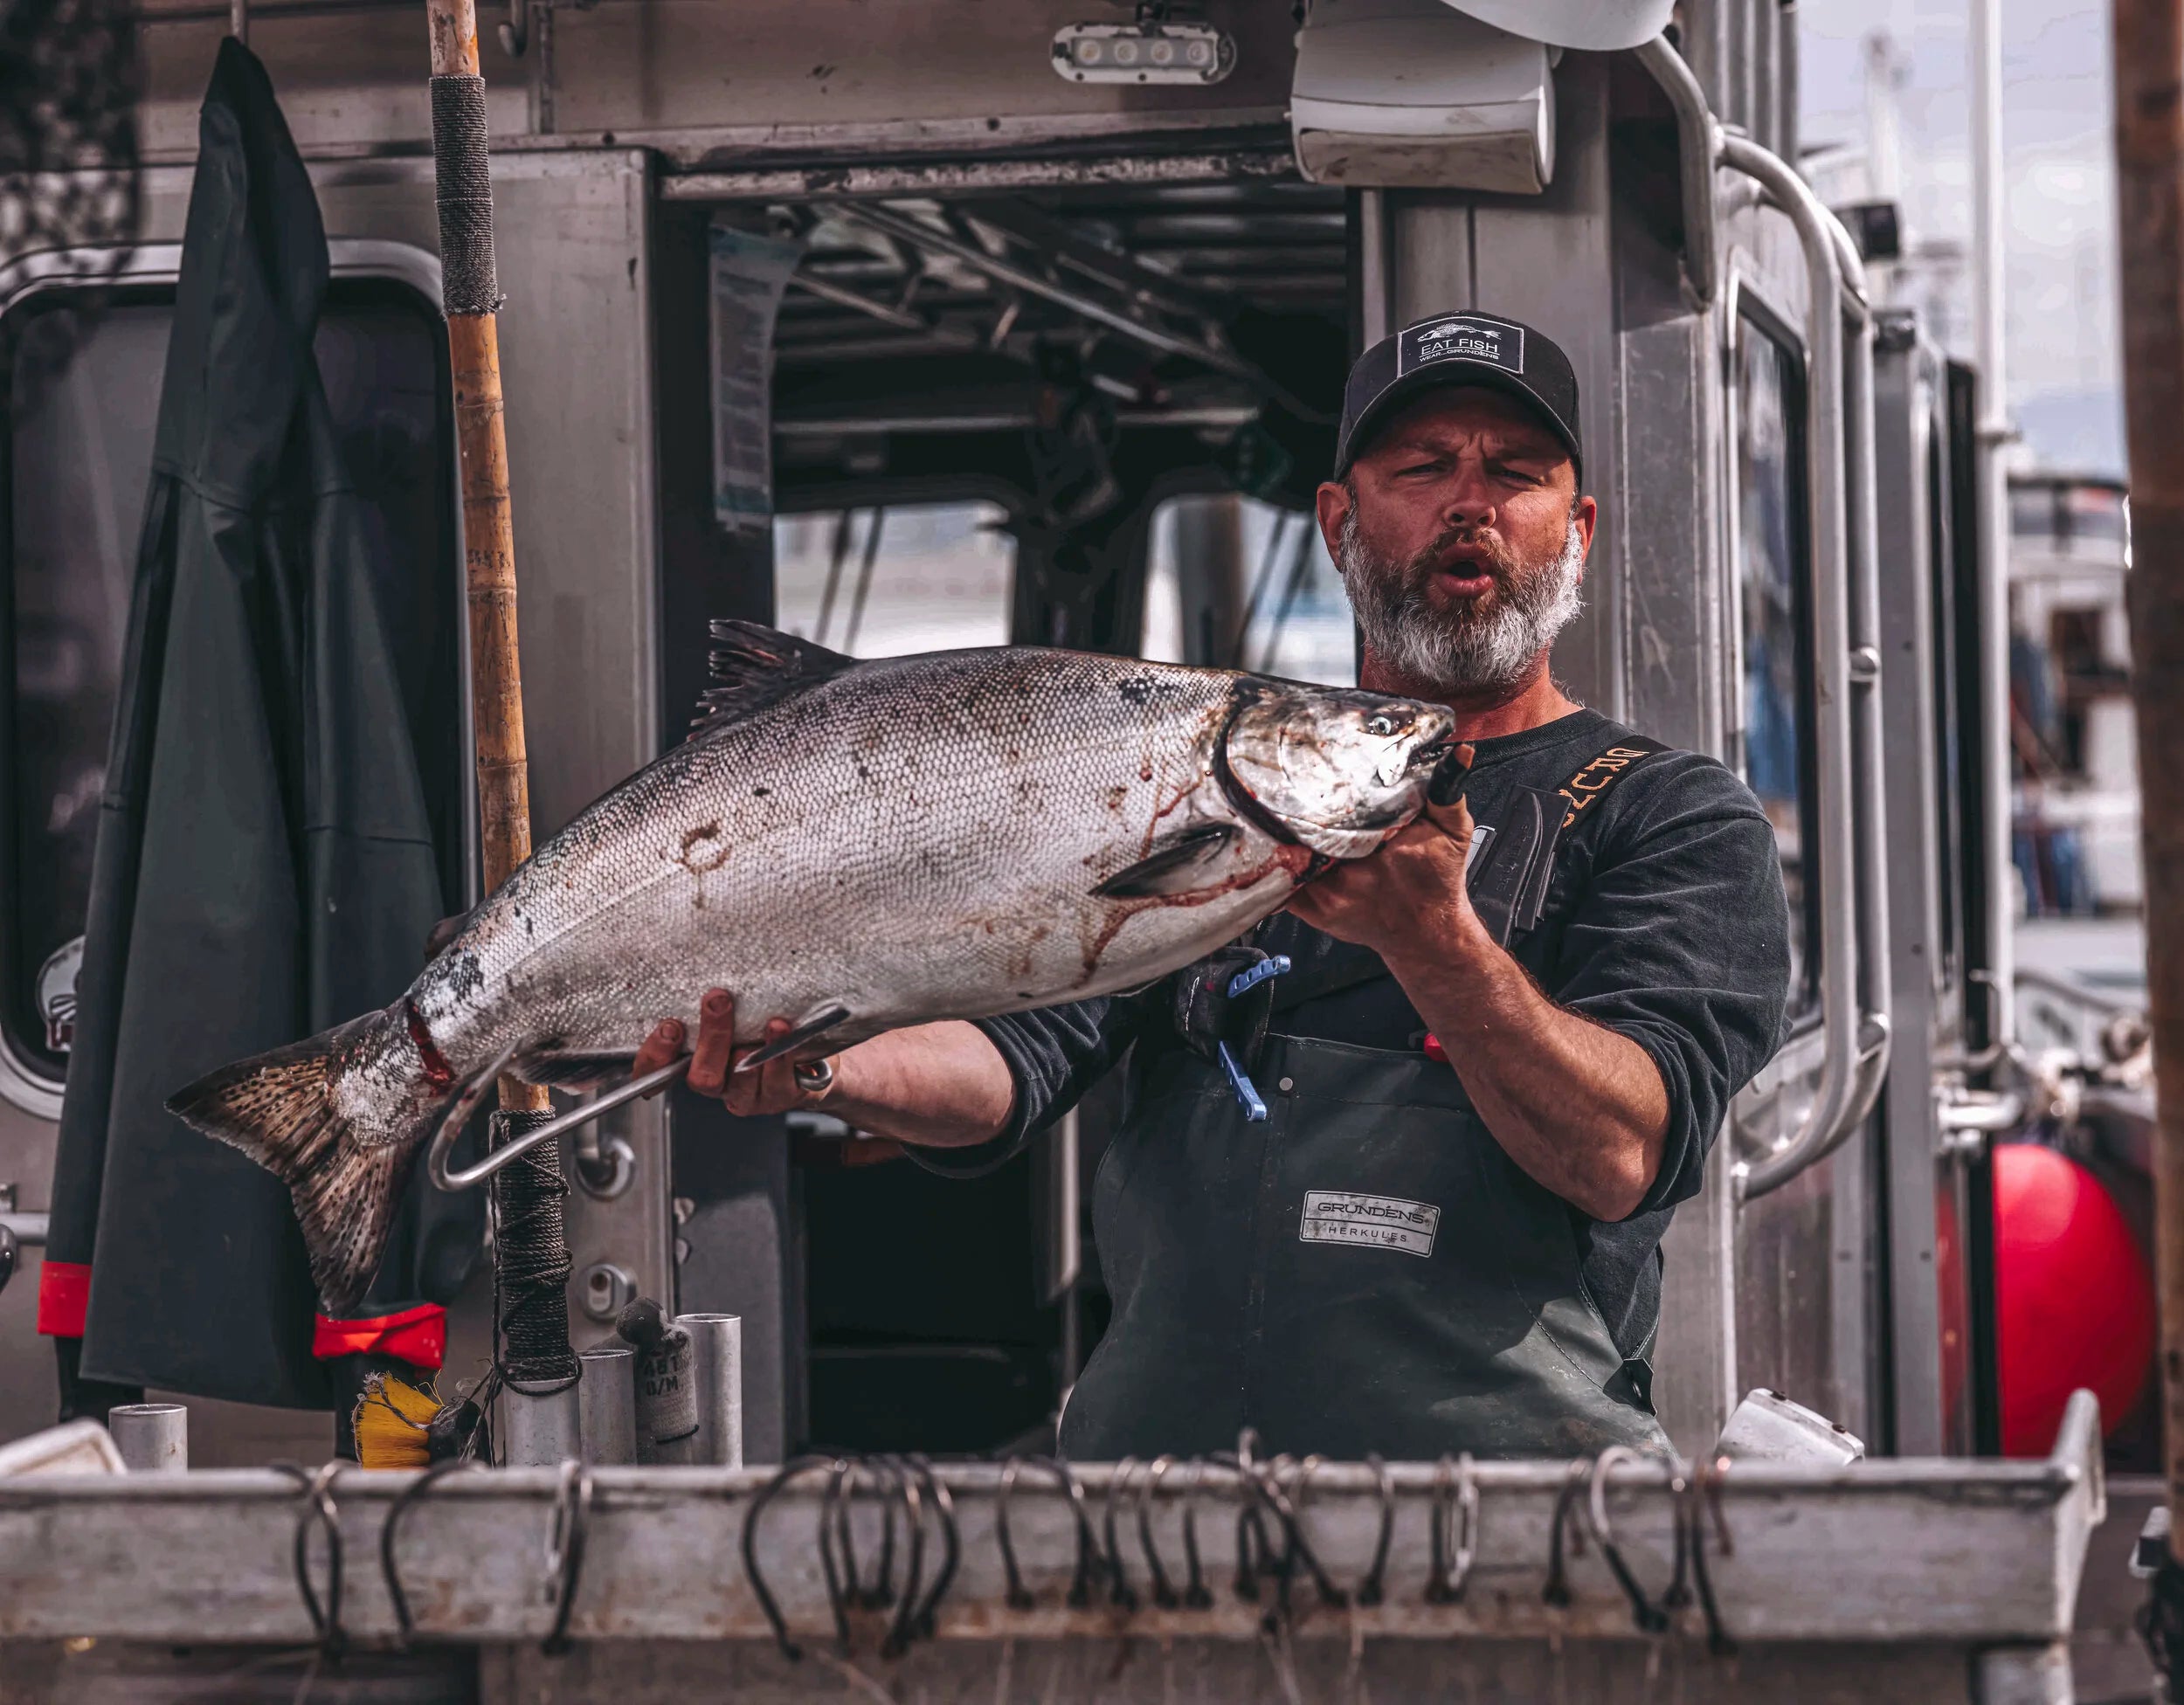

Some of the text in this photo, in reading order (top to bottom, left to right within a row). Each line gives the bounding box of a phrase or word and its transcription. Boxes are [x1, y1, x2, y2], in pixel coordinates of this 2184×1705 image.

[1421, 338, 1498, 355] EAT FISH
[1317, 1202, 1425, 1224] GRUNDÉNS
[1328, 1226, 1407, 1242] HERKULES
